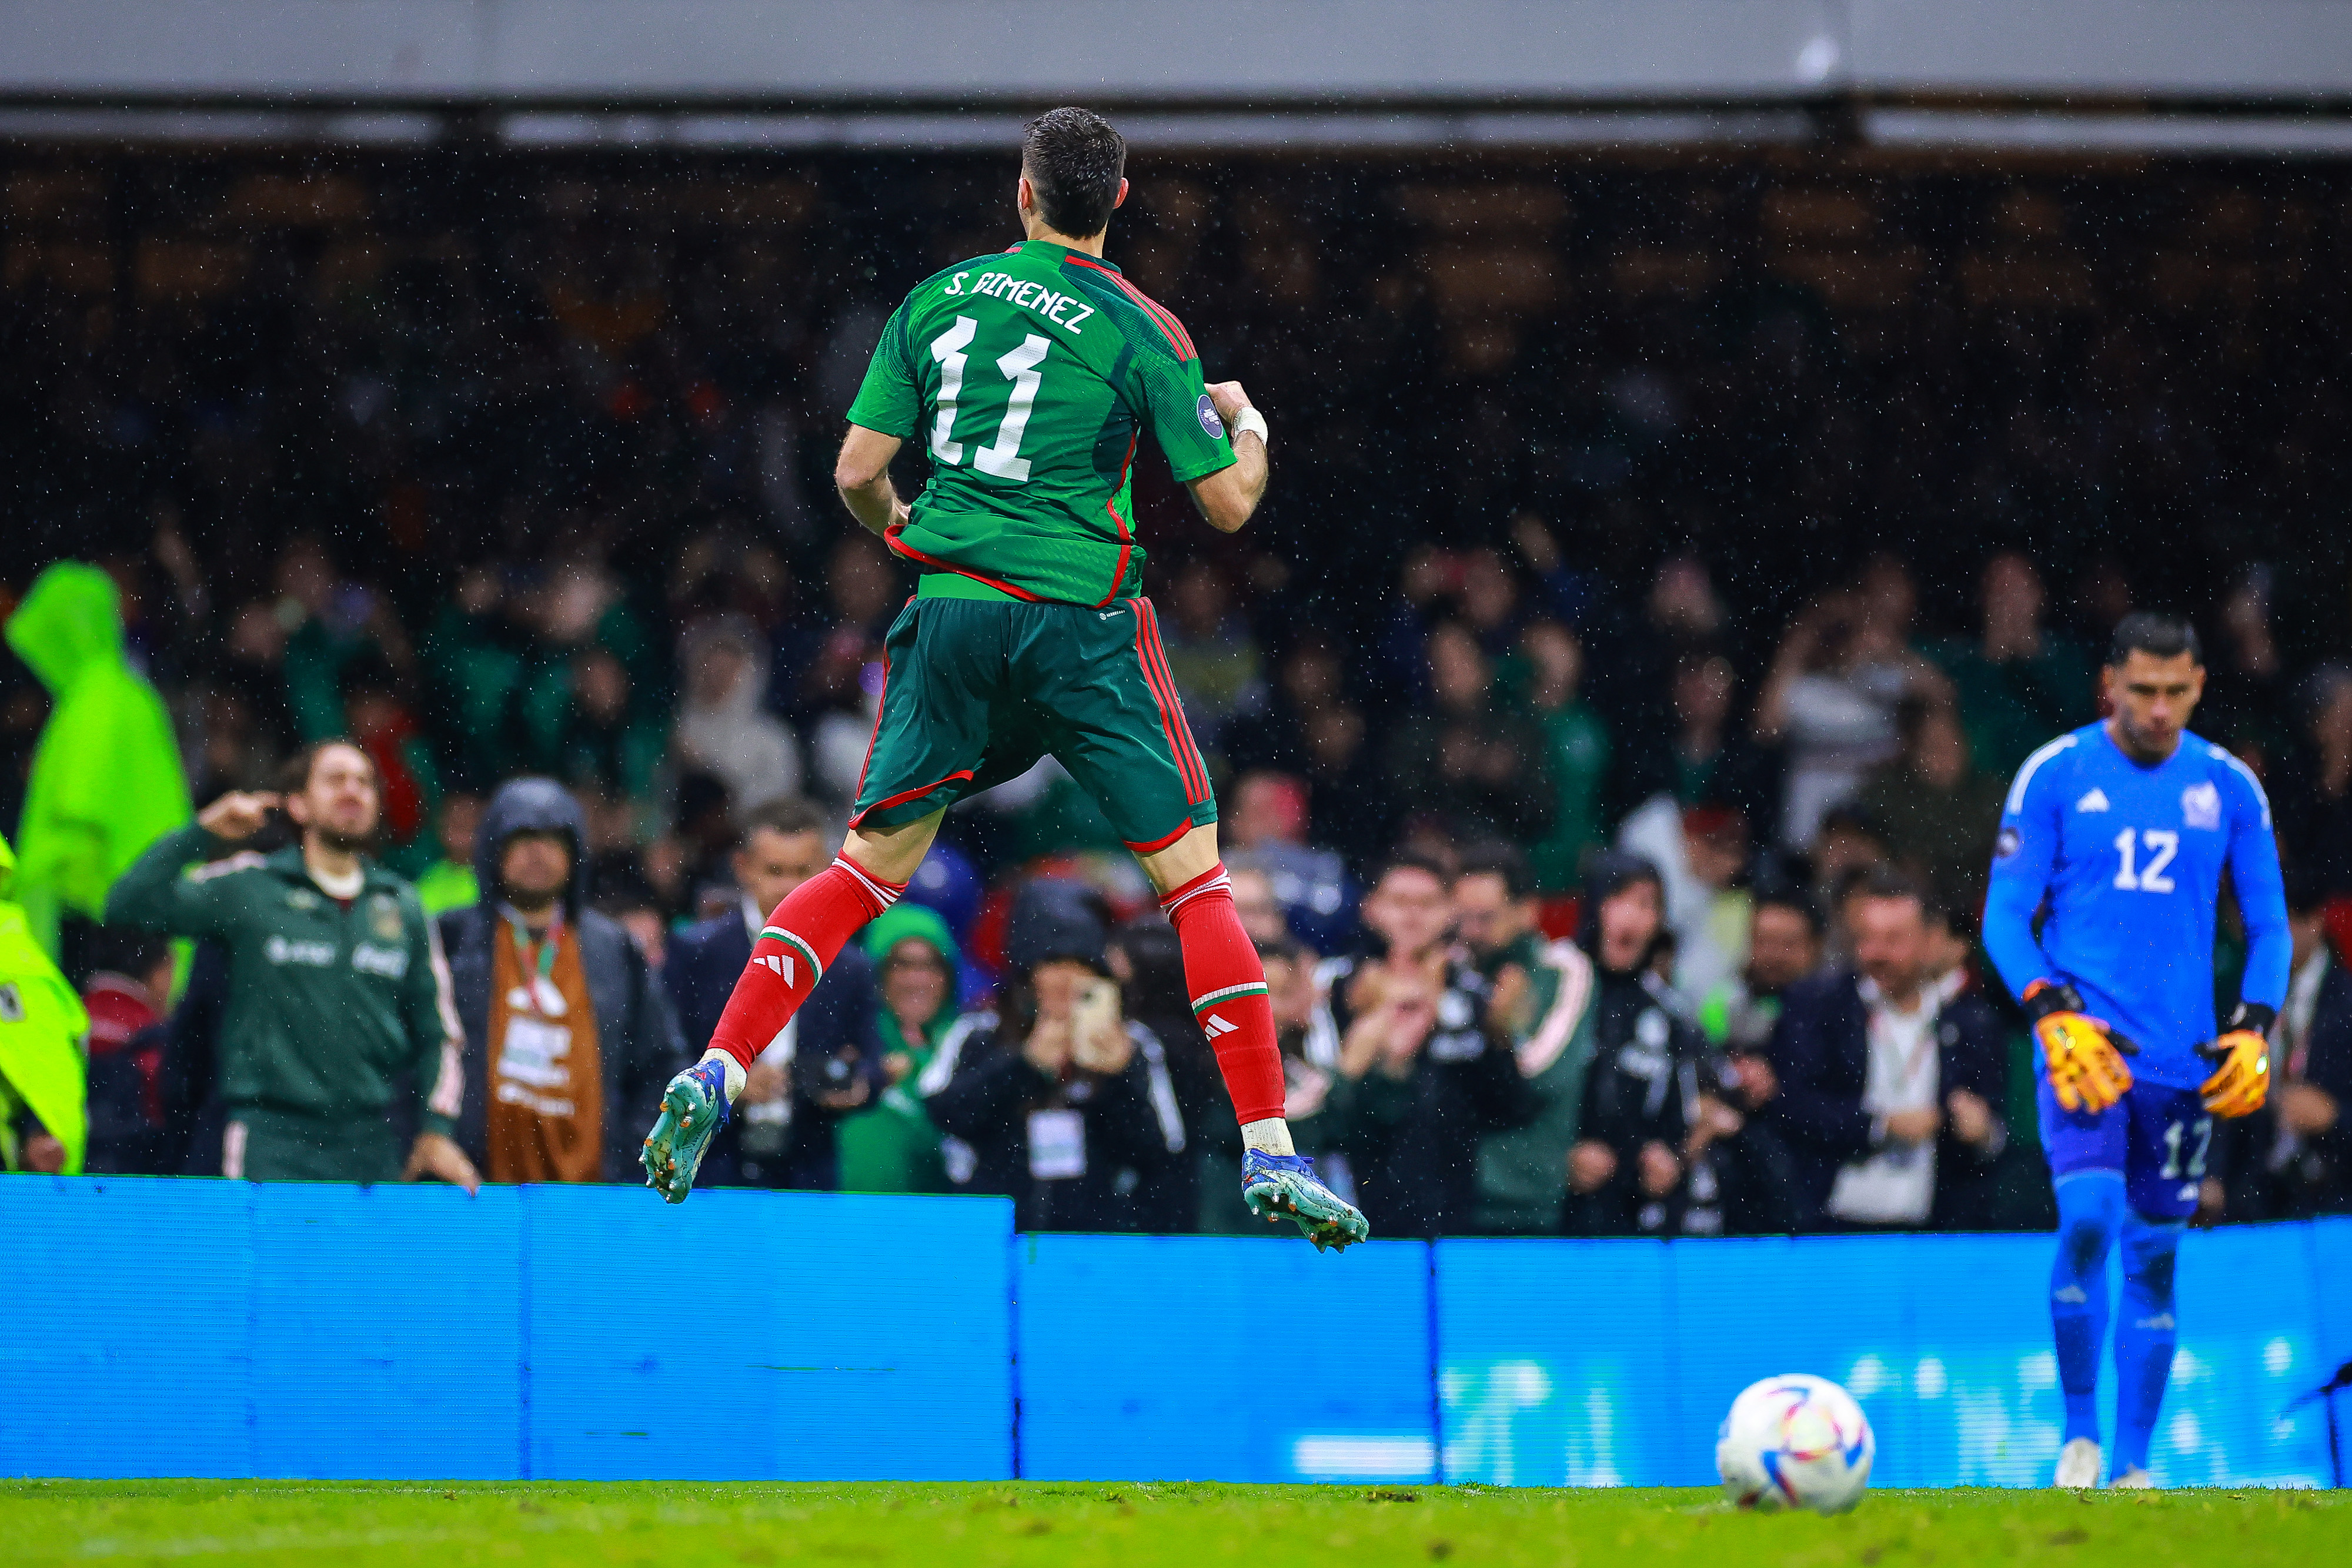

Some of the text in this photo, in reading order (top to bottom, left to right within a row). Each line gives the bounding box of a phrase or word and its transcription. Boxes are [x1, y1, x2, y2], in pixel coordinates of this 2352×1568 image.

[944, 272, 1095, 335] S. GIMENEZ
[930, 315, 1052, 482] 11
[2113, 828, 2180, 893] 12
[2160, 1118, 2213, 1179] 12
